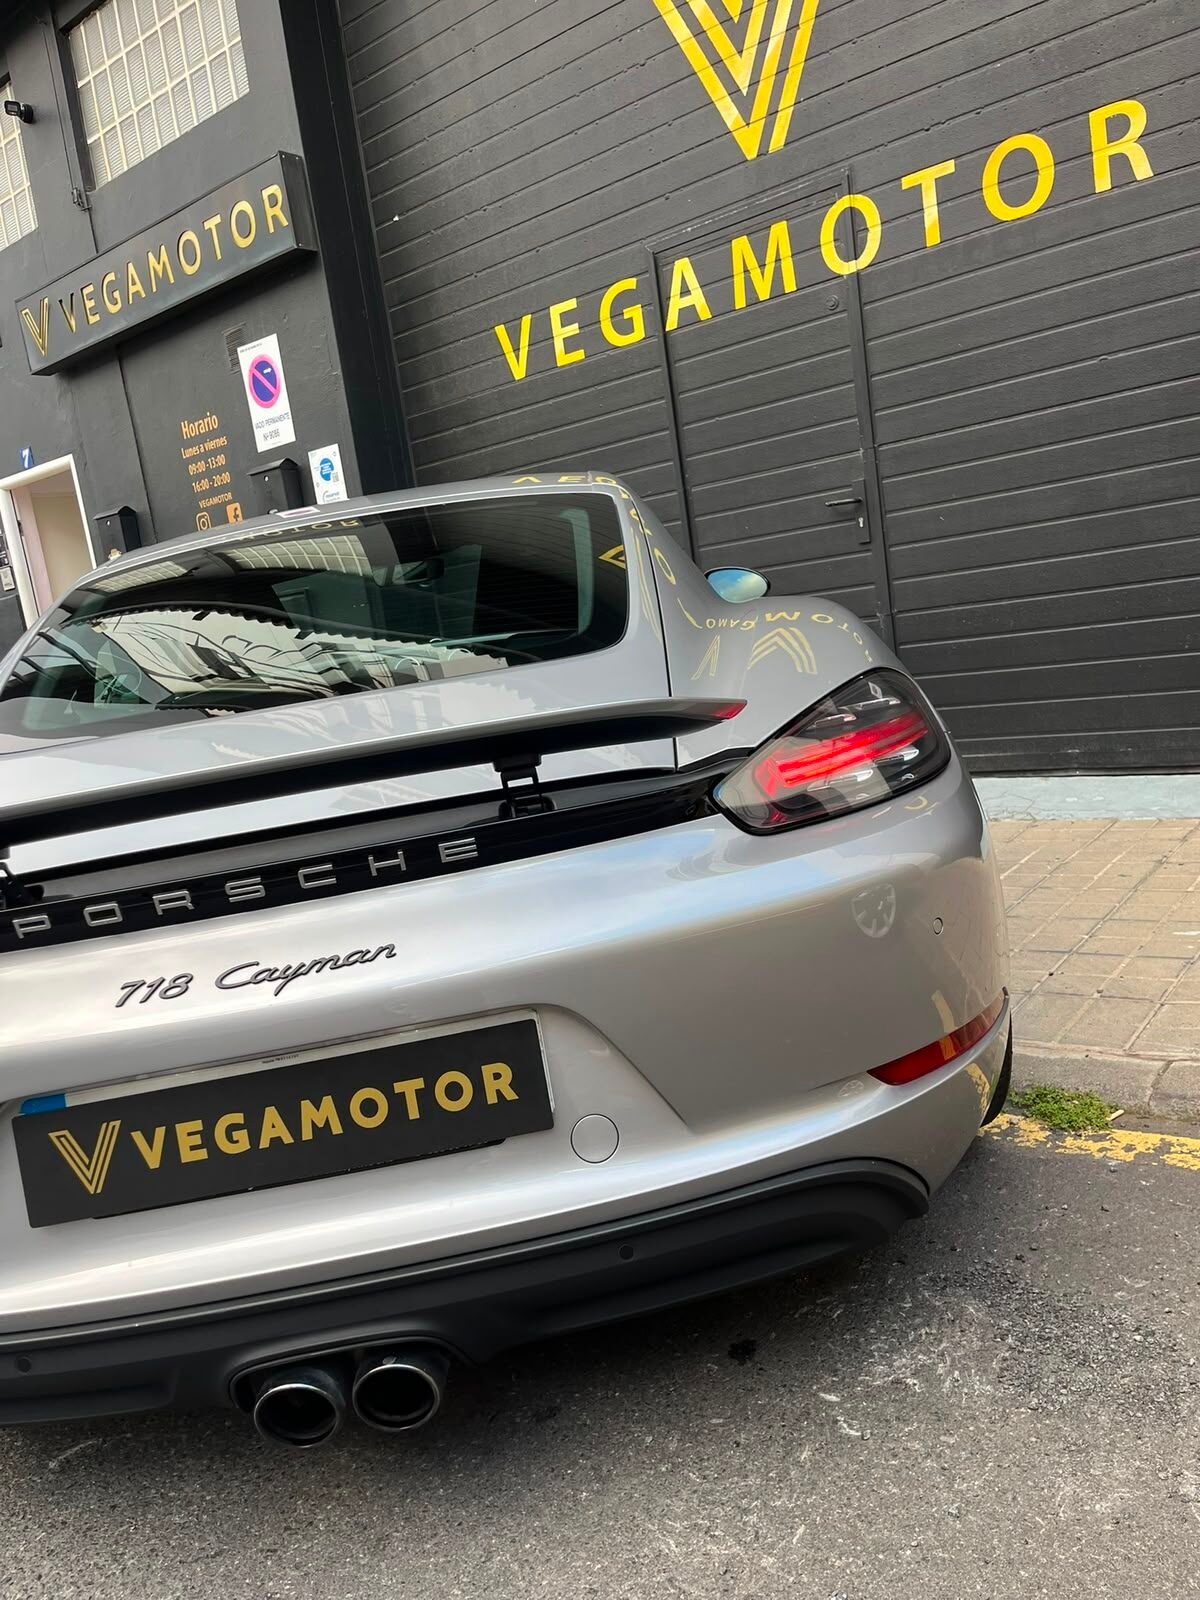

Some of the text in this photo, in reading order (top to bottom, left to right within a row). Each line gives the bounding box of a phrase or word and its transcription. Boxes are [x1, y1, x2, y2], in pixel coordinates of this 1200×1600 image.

[494, 99, 1153, 381] VEGAMOTOR
[58, 183, 289, 334] VEGAMOTOR
[181, 411, 219, 440] Horario
[22, 449, 30, 469] 7
[181, 445, 200, 459] Lunes
[204, 436, 228, 452] viernes
[188, 460, 206, 476] 09:00
[208, 454, 226, 469] 13:00
[192, 478, 210, 493] 16:00
[213, 471, 231, 487] 20:00
[199, 492, 233, 509] VEGAMOTOR
[13, 837, 479, 939] PORSCHE
[115, 943, 397, 1007] 718 Cayman
[131, 1061, 519, 1170] VEGAMOTOR
